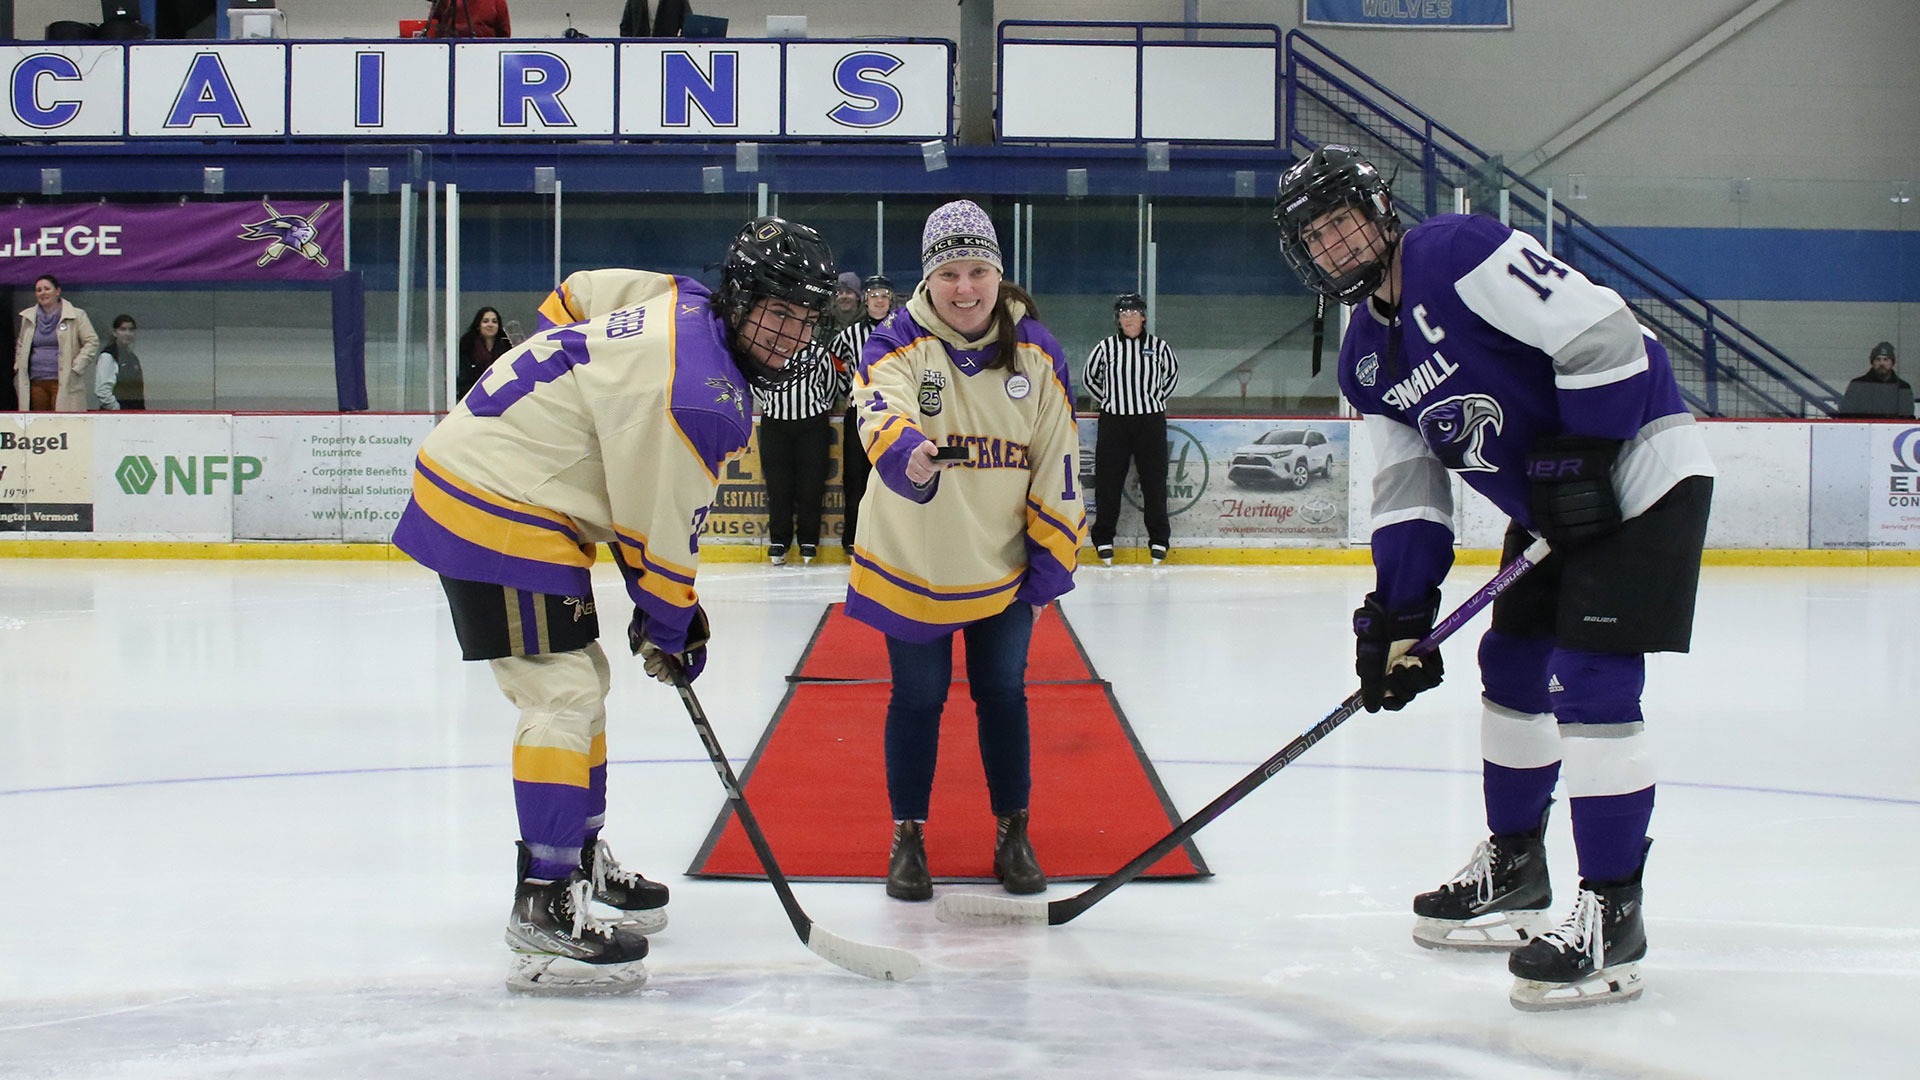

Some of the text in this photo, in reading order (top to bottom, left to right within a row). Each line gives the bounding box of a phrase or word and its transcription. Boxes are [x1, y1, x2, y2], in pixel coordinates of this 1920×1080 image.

[1363, 0, 1452, 18] WOLVES
[935, 238, 960, 251] ICE
[1508, 247, 1569, 301] 14
[1412, 303, 1446, 345] C
[921, 390, 940, 407] 25
[0, 432, 68, 454] Bagel
[311, 435, 413, 447] Property & Casualty
[312, 448, 362, 457] Insurance
[164, 455, 263, 495] NFP
[312, 466, 408, 477] Corporate Benefits
[312, 485, 364, 495] Individual
[33, 511, 79, 521] Vermont
[312, 507, 404, 522] www.nfp.co
[1219, 499, 1294, 523] Heritage
[1583, 615, 1618, 624] BAUER
